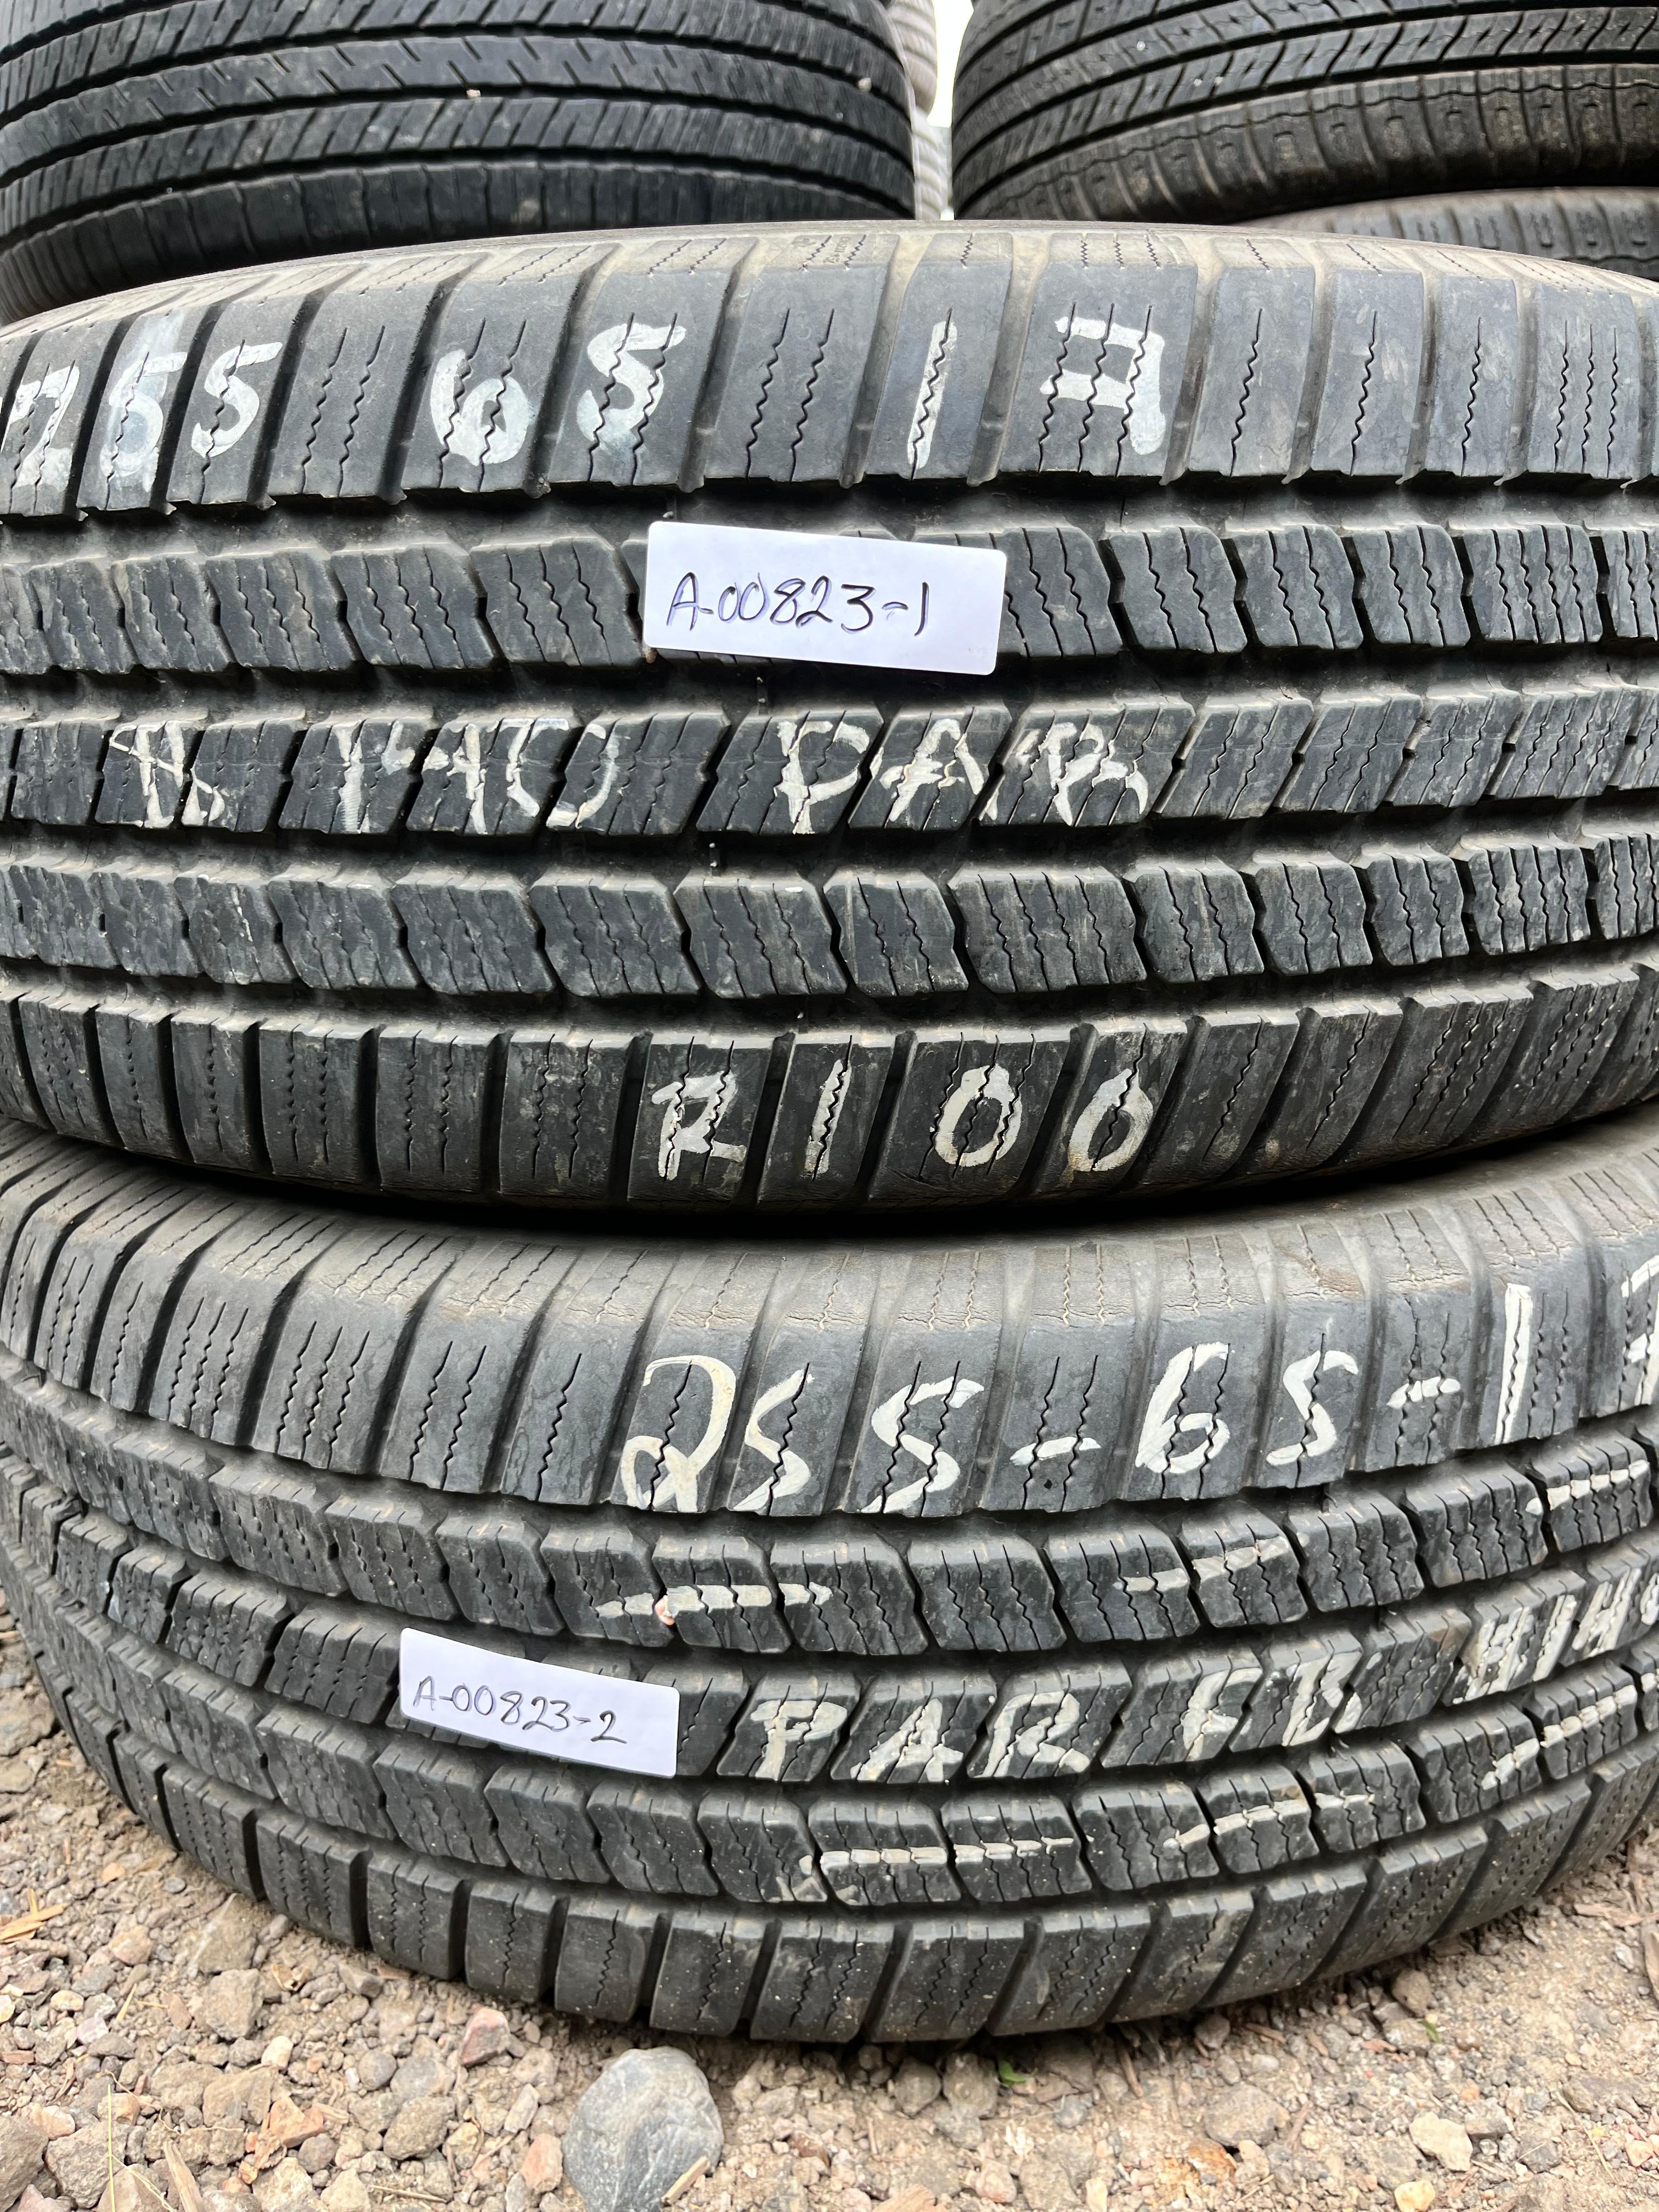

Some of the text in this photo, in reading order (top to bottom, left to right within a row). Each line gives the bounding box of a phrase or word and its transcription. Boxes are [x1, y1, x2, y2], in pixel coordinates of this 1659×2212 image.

[665, 571, 931, 637] A-00823-1
[774, 718, 1150, 834] PAR
[413, 1675, 628, 1744] A-00823-2
[749, 1698, 1091, 1782] PAR
